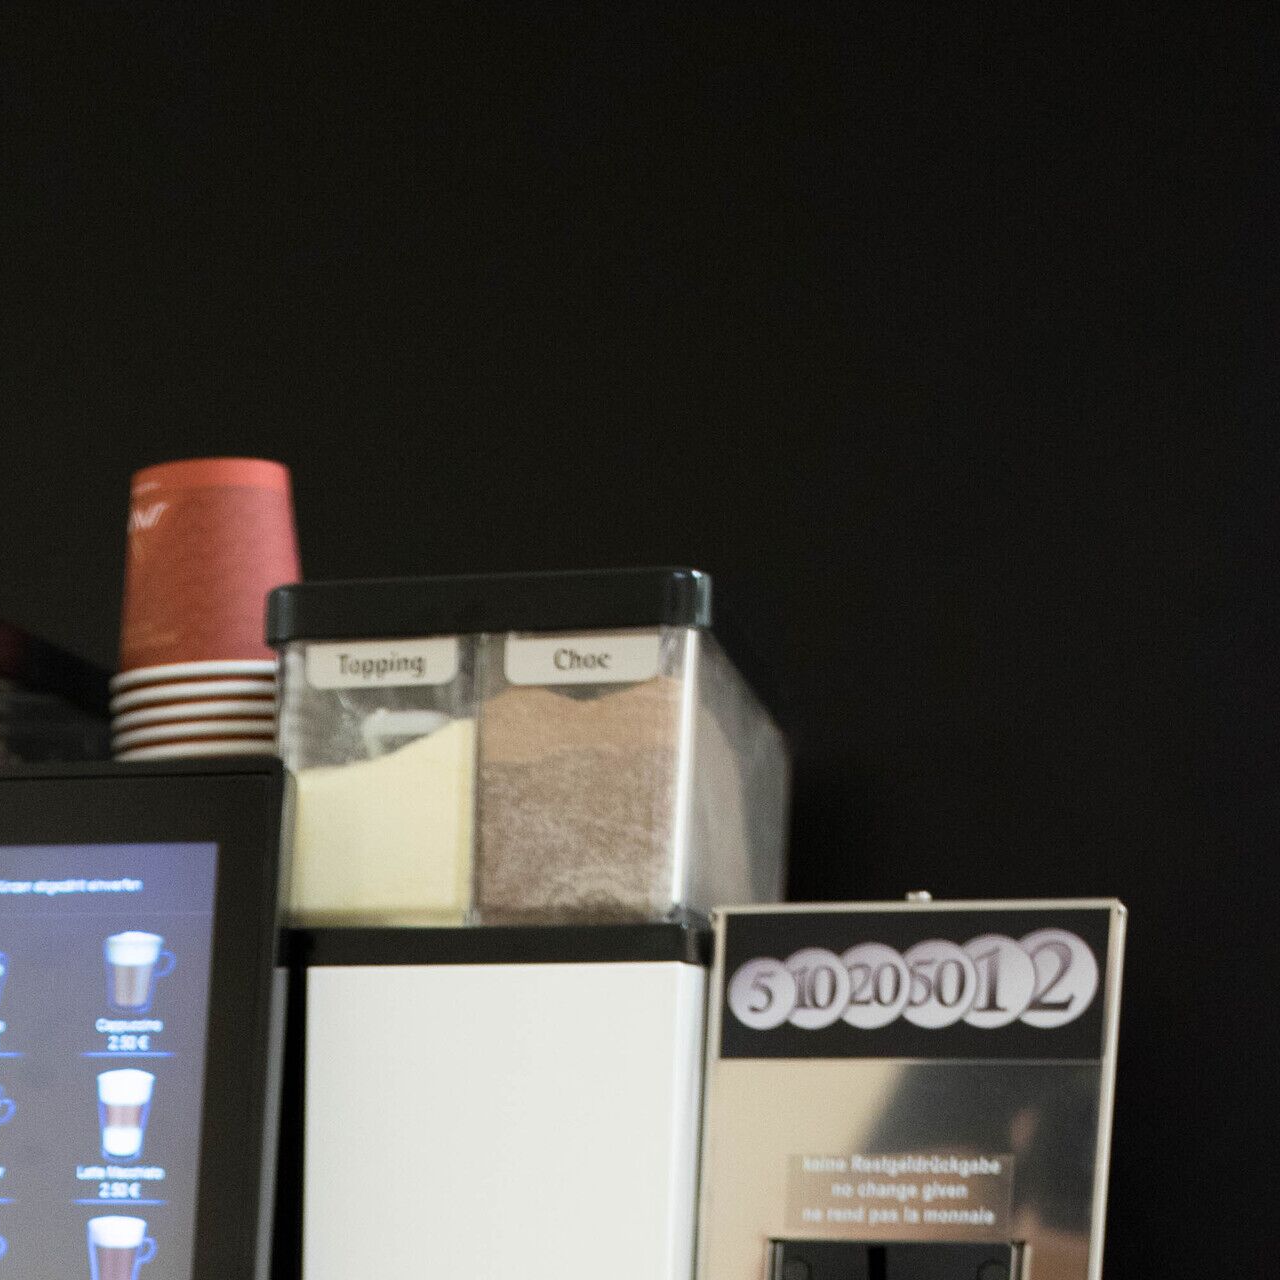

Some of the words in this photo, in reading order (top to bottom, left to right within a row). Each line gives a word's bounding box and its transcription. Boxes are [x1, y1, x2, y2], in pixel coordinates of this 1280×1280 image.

[338, 651, 426, 678] Topping
[553, 648, 612, 671] Choc
[749, 971, 775, 1013] 5
[794, 965, 838, 1010] 10
[847, 961, 902, 1006] 20
[908, 957, 967, 1008] 50
[972, 947, 1008, 1011] 1
[1028, 938, 1076, 1012] 2
[831, 1184, 854, 1198] no
[857, 1181, 918, 1202] change
[922, 1181, 969, 1202] given
[826, 1205, 864, 1223] rend
[868, 1208, 899, 1226] pas
[903, 1206, 919, 1223] la
[923, 1206, 995, 1225] monnaie
